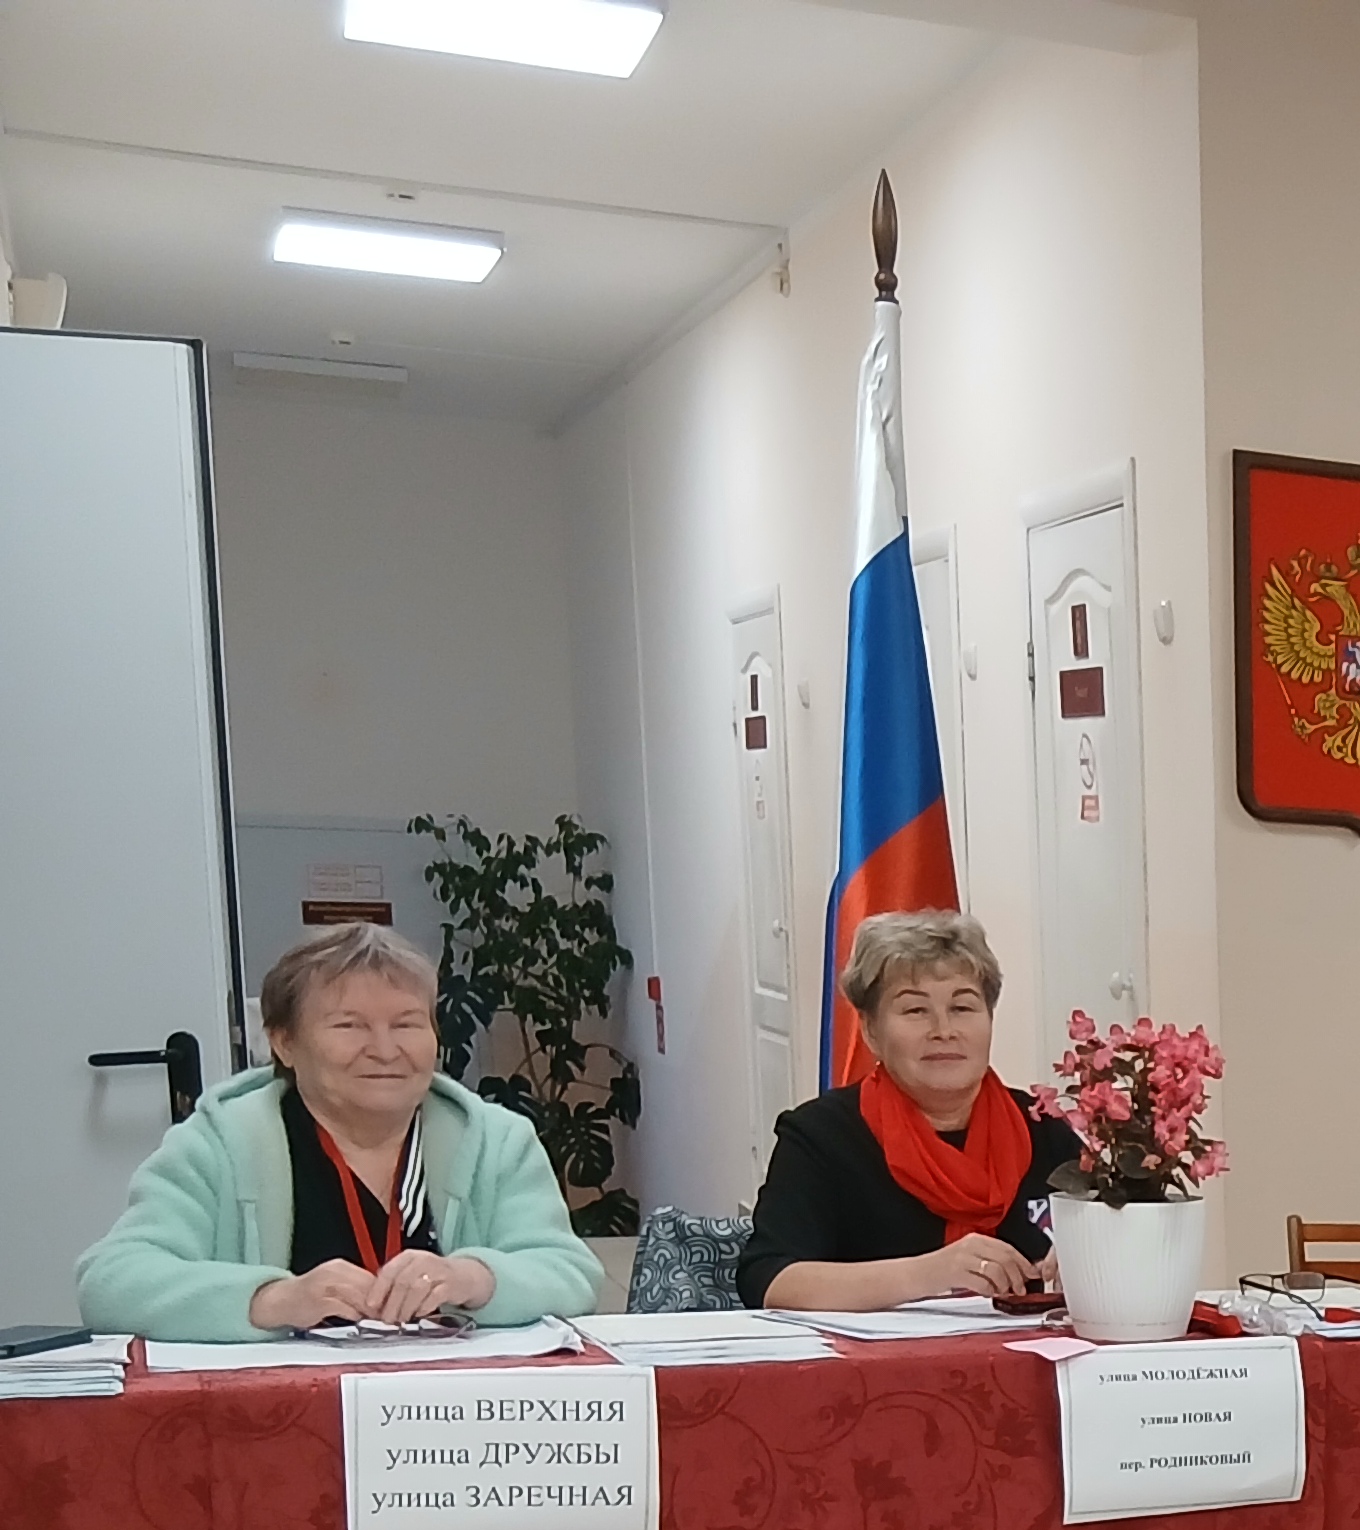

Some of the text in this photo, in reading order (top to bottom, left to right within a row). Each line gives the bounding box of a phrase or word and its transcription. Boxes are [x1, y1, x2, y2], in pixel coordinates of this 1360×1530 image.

[1099, 1367, 1249, 1385] улица МОЛОДЁЖНАЯ
[381, 1399, 625, 1426] улица ВЕРХНЯЯ
[1140, 1411, 1232, 1428] улица НОВАЯ
[386, 1442, 619, 1470] улица ДРУЖБЫ
[1120, 1450, 1252, 1472] пер. РОДНИКОВЫЙ
[371, 1485, 633, 1514] улица ЗАРЕЧНАЯ
